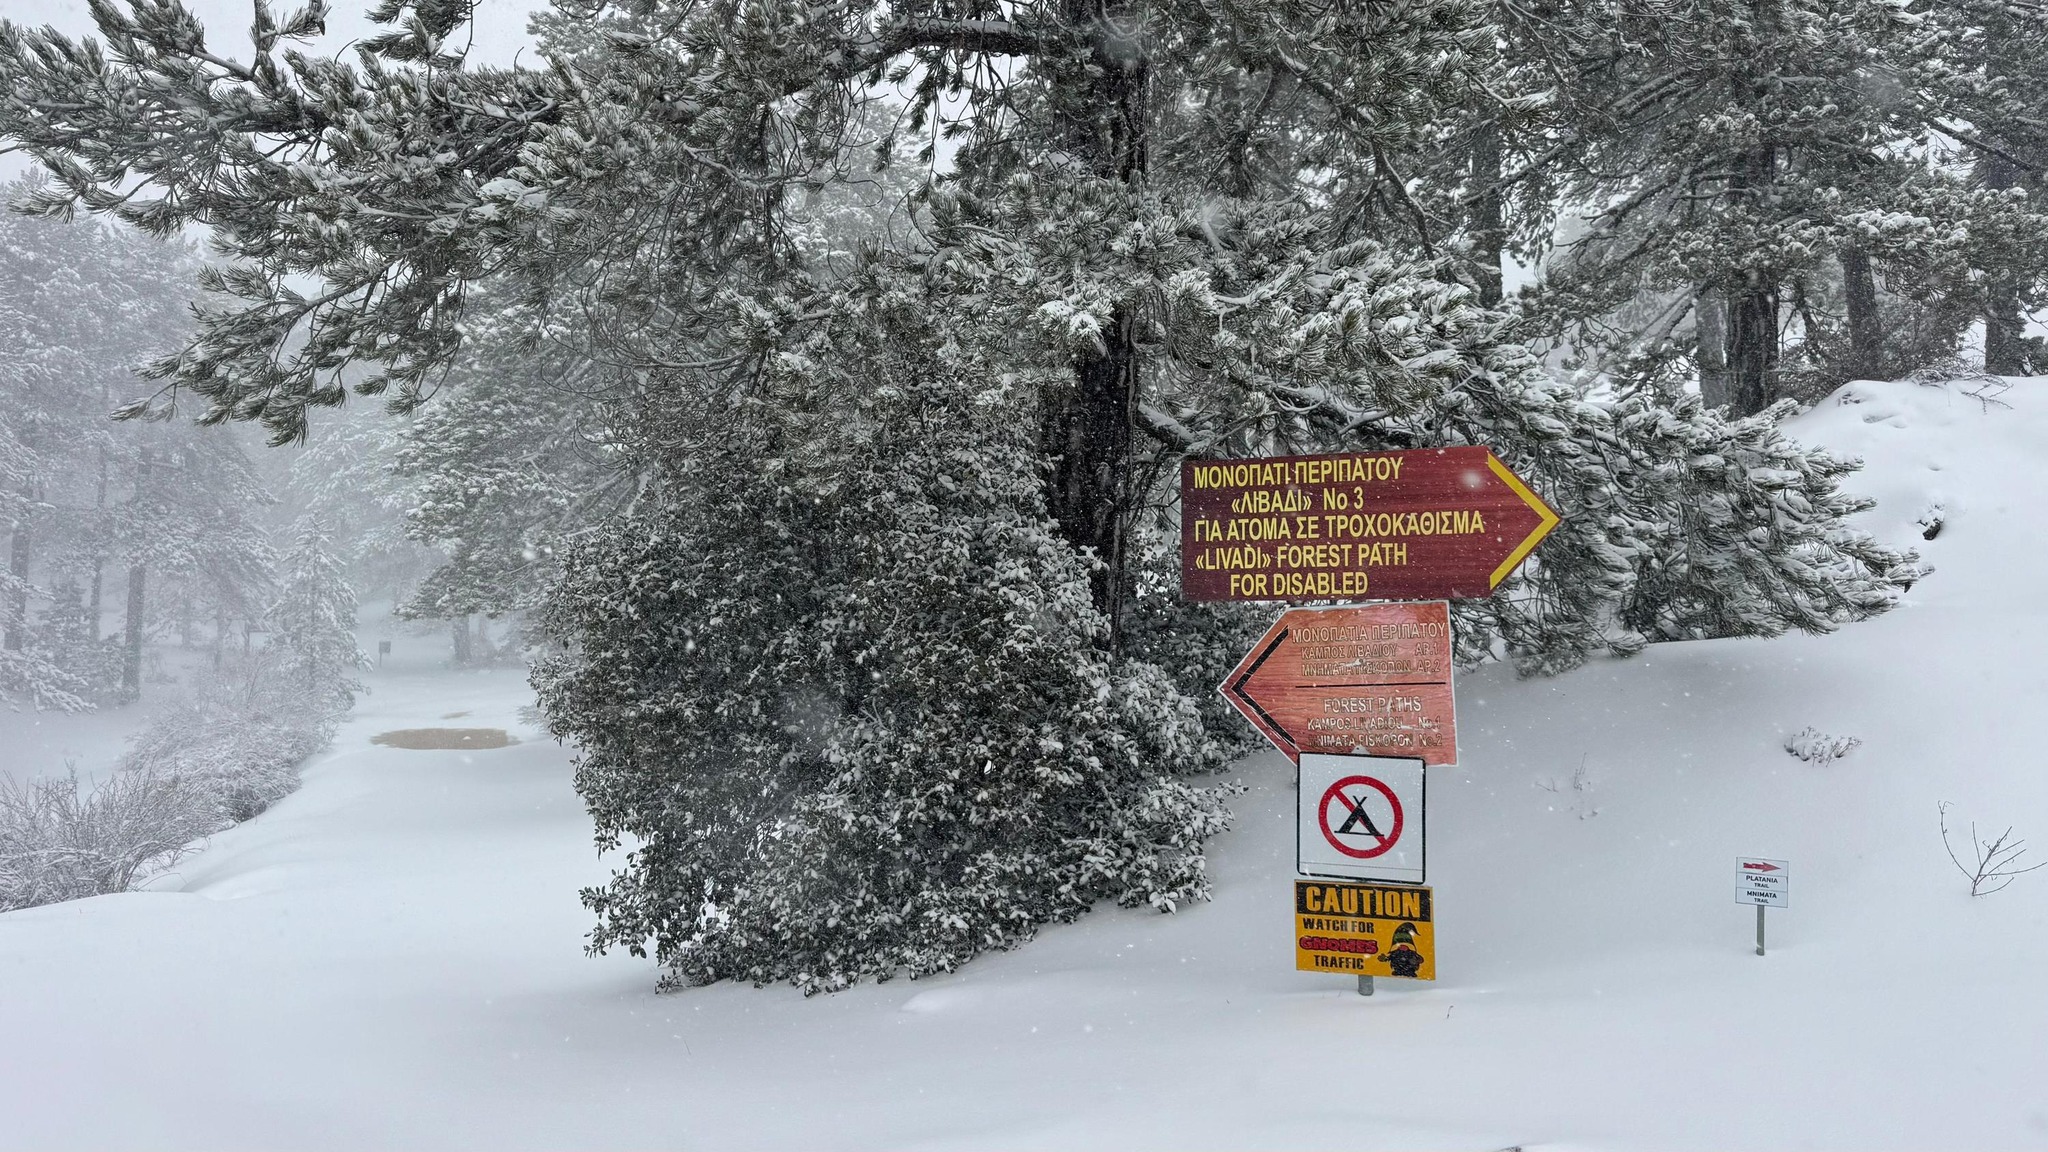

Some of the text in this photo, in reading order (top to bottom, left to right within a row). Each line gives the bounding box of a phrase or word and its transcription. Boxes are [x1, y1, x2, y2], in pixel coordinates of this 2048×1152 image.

[1194, 456, 1404, 489] ΜΟΝΟΠΑΤΙ ΠΕΡΙΠΑΤΟΥ
[1231, 486, 1364, 514] «ΛΙΒΑΔΙ» No 3
[1195, 510, 1486, 542] ΓΙΑ ΑΤΟΜΑ ΣΕ ΤΡΟΧΟΚΑΘΙΣΜΑ
[1195, 542, 1407, 570] «LIVADI» FOREST PATH
[1230, 571, 1368, 596] FOR DISABLED
[1292, 622, 1446, 643] ΜΟΝΟΠΑΤΙΑ ΠΕΡΙΠΑΤΟΥ
[1301, 645, 1345, 659] ΚΑΜΠΟΣ
[1347, 643, 1397, 659] ΛΙΒΑΔΙΟΥ
[1324, 696, 1422, 713] FOREST PATHS
[1307, 717, 1351, 730] KAMPOS
[1746, 875, 1778, 883] PLATANIA
[1305, 886, 1421, 918] CAUTION
[1303, 917, 1375, 934] WATCH FOR
[1299, 935, 1379, 955] GNOMES
[1313, 954, 1365, 970] TRAFFIC
